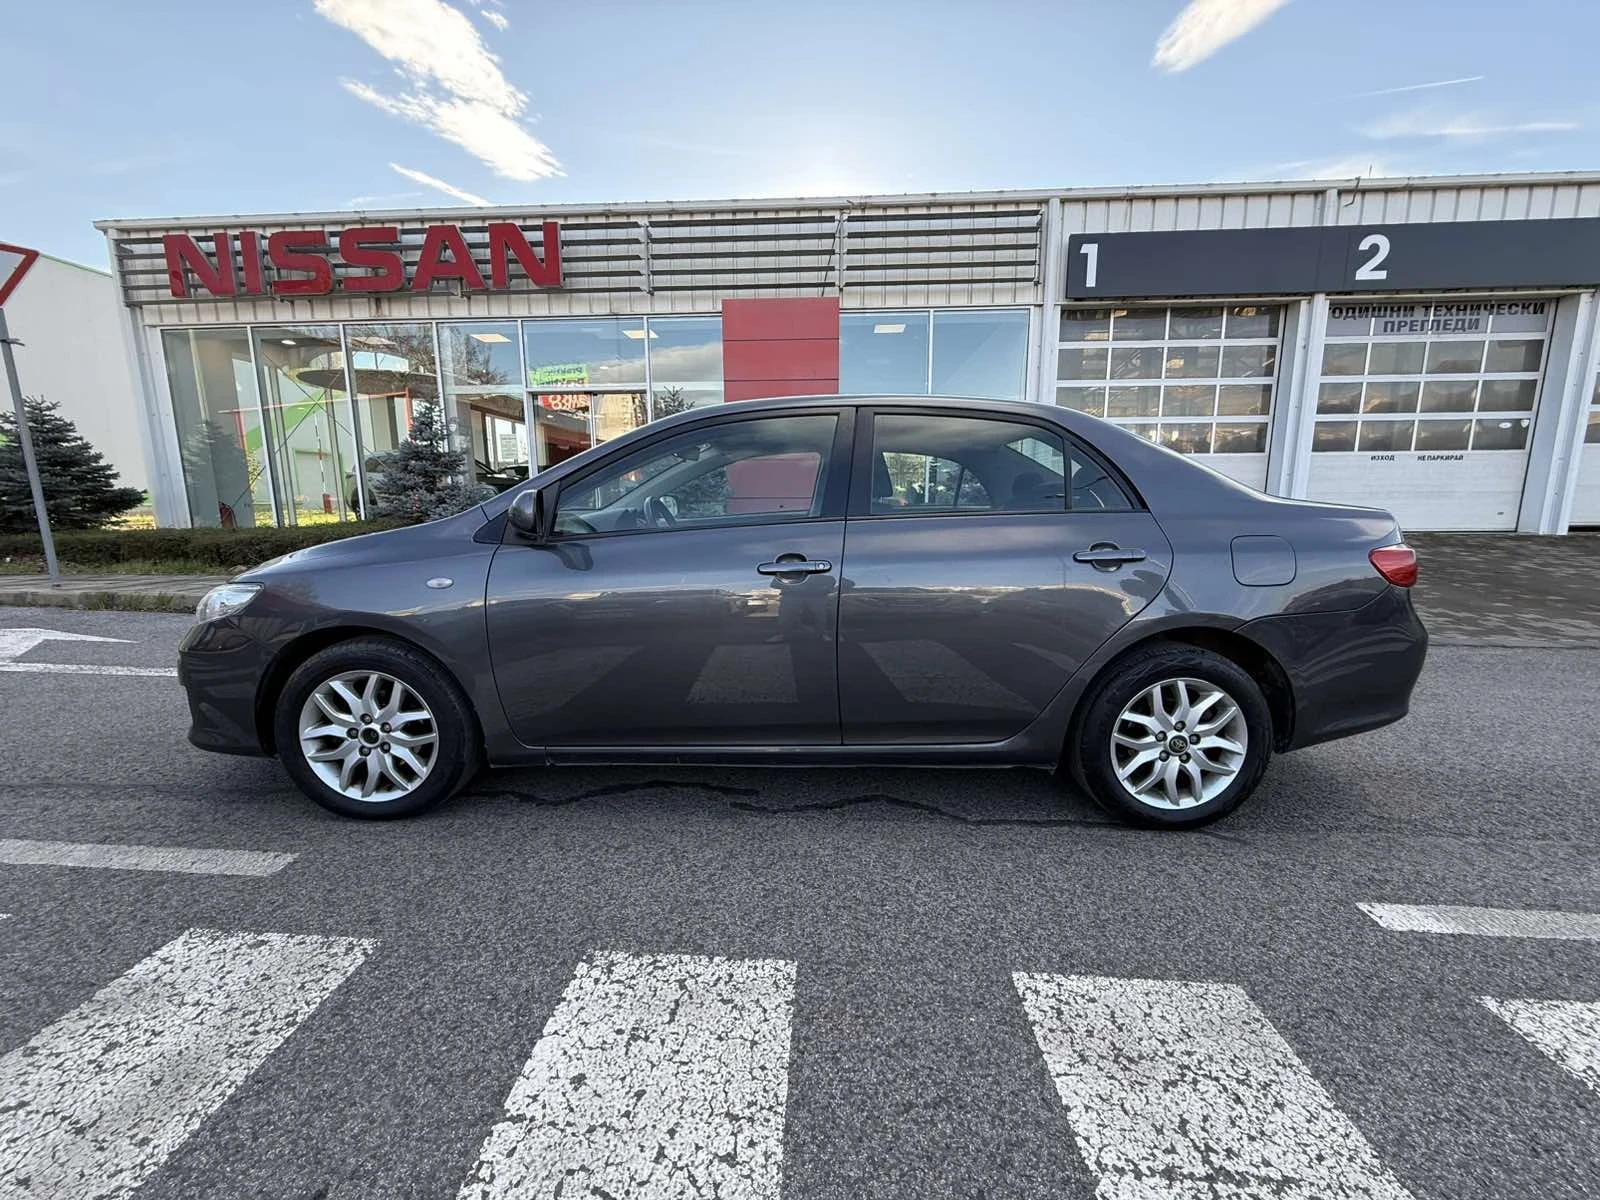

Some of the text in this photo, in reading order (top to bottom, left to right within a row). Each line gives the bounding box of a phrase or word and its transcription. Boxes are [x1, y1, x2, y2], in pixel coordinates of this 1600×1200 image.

[163, 221, 564, 298] NISSAN
[1079, 243, 1099, 288] 1
[1355, 233, 1391, 281] 2
[1329, 302, 1545, 320] ОДИШНИ ТЕХНИЧЕСКИ
[1383, 318, 1480, 333] ПРЕГЛЕДИ
[1370, 454, 1396, 462] ИЗХОД
